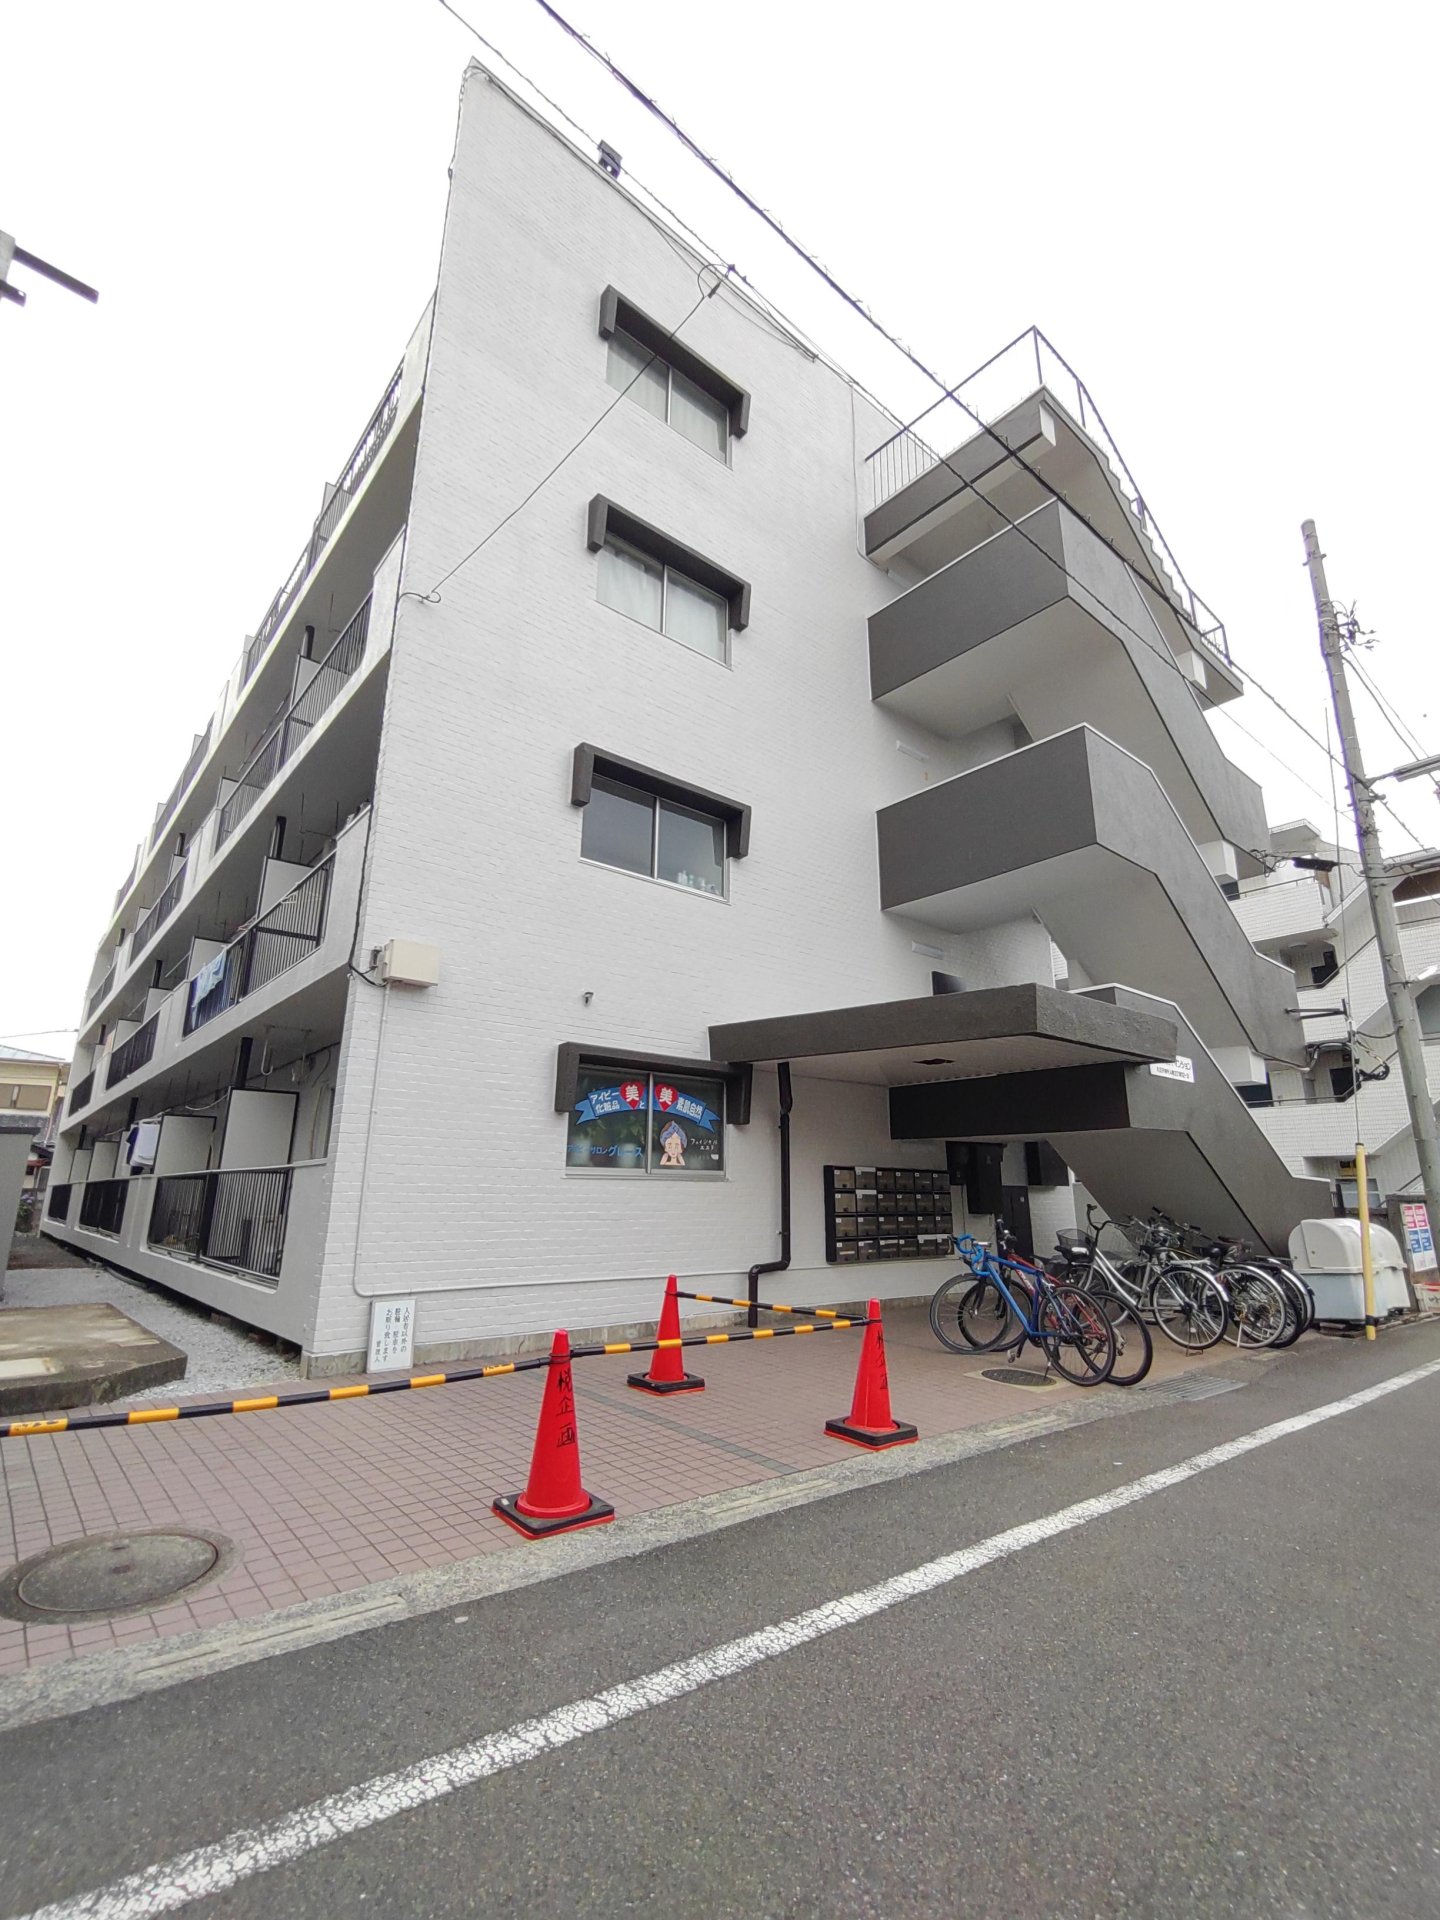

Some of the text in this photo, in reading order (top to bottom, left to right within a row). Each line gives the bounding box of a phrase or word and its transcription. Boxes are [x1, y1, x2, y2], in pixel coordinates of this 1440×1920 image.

[590, 1089, 620, 1105] アイビー
[625, 1084, 640, 1102] 美
[659, 1087, 673, 1105] 美
[595, 1100, 620, 1114] 化粧品
